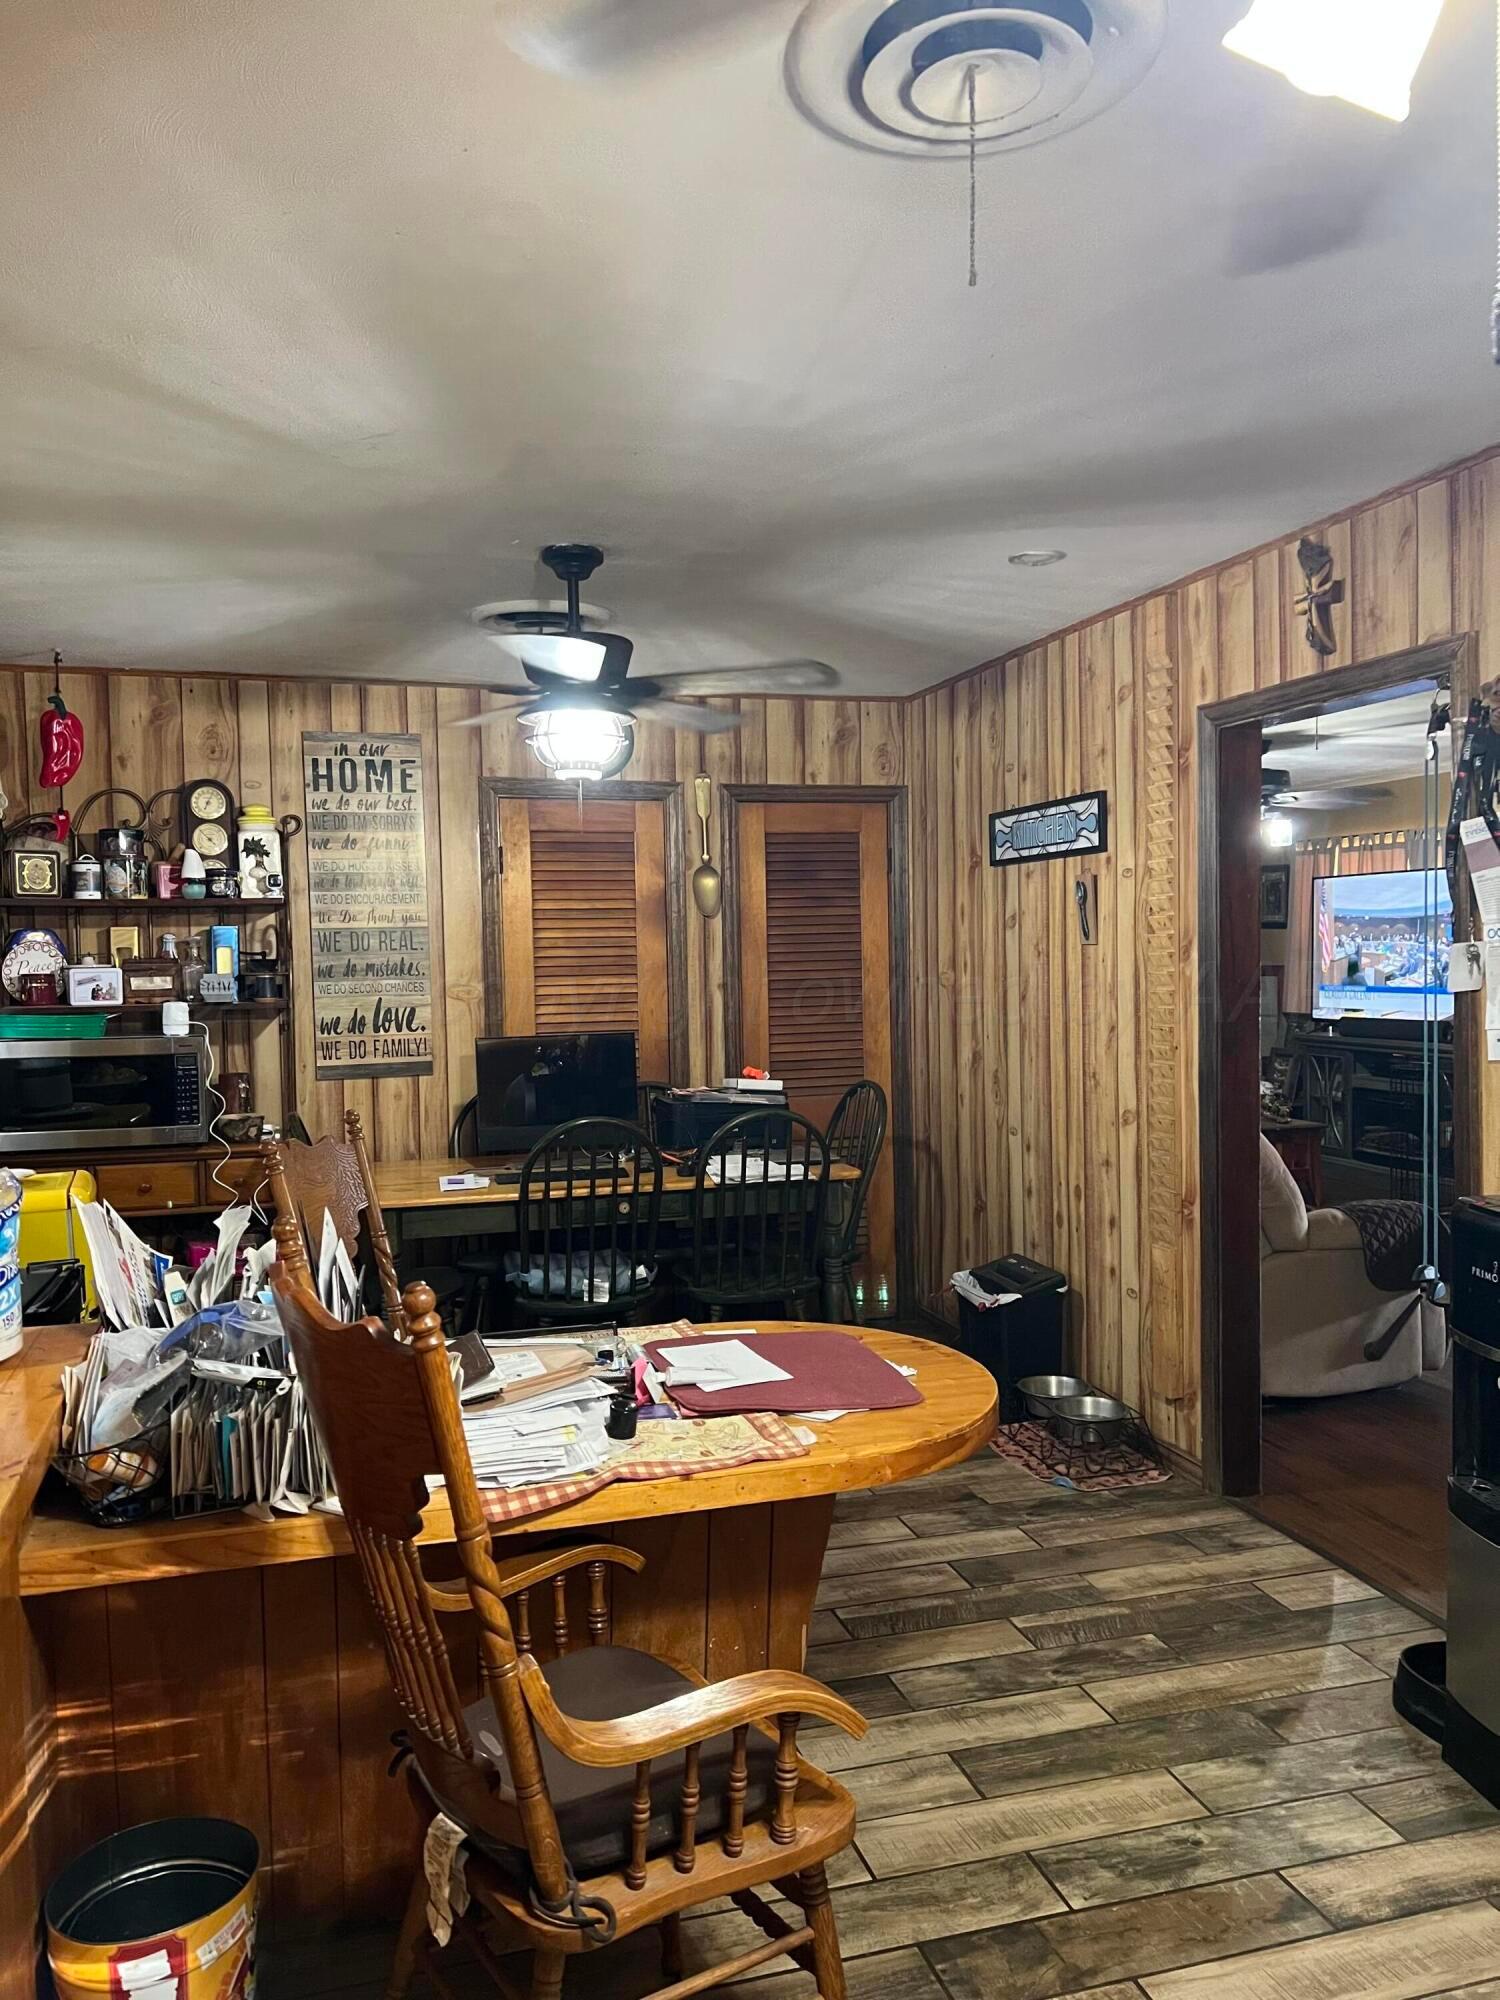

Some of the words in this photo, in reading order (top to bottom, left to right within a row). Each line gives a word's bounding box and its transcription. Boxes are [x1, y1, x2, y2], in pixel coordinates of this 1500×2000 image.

[334, 743, 349, 756] in
[359, 743, 390, 757] our
[311, 757, 417, 793] HOME
[311, 798, 330, 811] we
[336, 795, 349, 811] do
[357, 799, 380, 811] our
[386, 795, 417, 811] best.
[311, 815, 329, 830] WE
[333, 815, 348, 830] DO
[311, 838, 332, 850] we
[341, 833, 358, 850] do
[312, 861, 328, 872] WE
[331, 861, 345, 872] DO
[314, 893, 328, 905] WE
[331, 893, 343, 905] DO
[317, 931, 343, 952] WE
[350, 931, 371, 951] DO
[379, 930, 424, 951] REAL.
[18, 960, 53, 975] Peace
[317, 964, 335, 978] we
[343, 958, 357, 978] do
[365, 957, 425, 978] mistakes.
[318, 984, 332, 995] WE
[334, 983, 347, 994] DO
[349, 983, 383, 994] SECOND
[320, 1016, 343, 1035] we
[347, 1008, 366, 1035] do
[372, 997, 427, 1033] love.
[320, 1040, 342, 1060] WE
[349, 1039, 367, 1060] DO
[373, 1037, 428, 1058] FAMILY!
[1471, 1266, 1499, 1283] PRIMO
